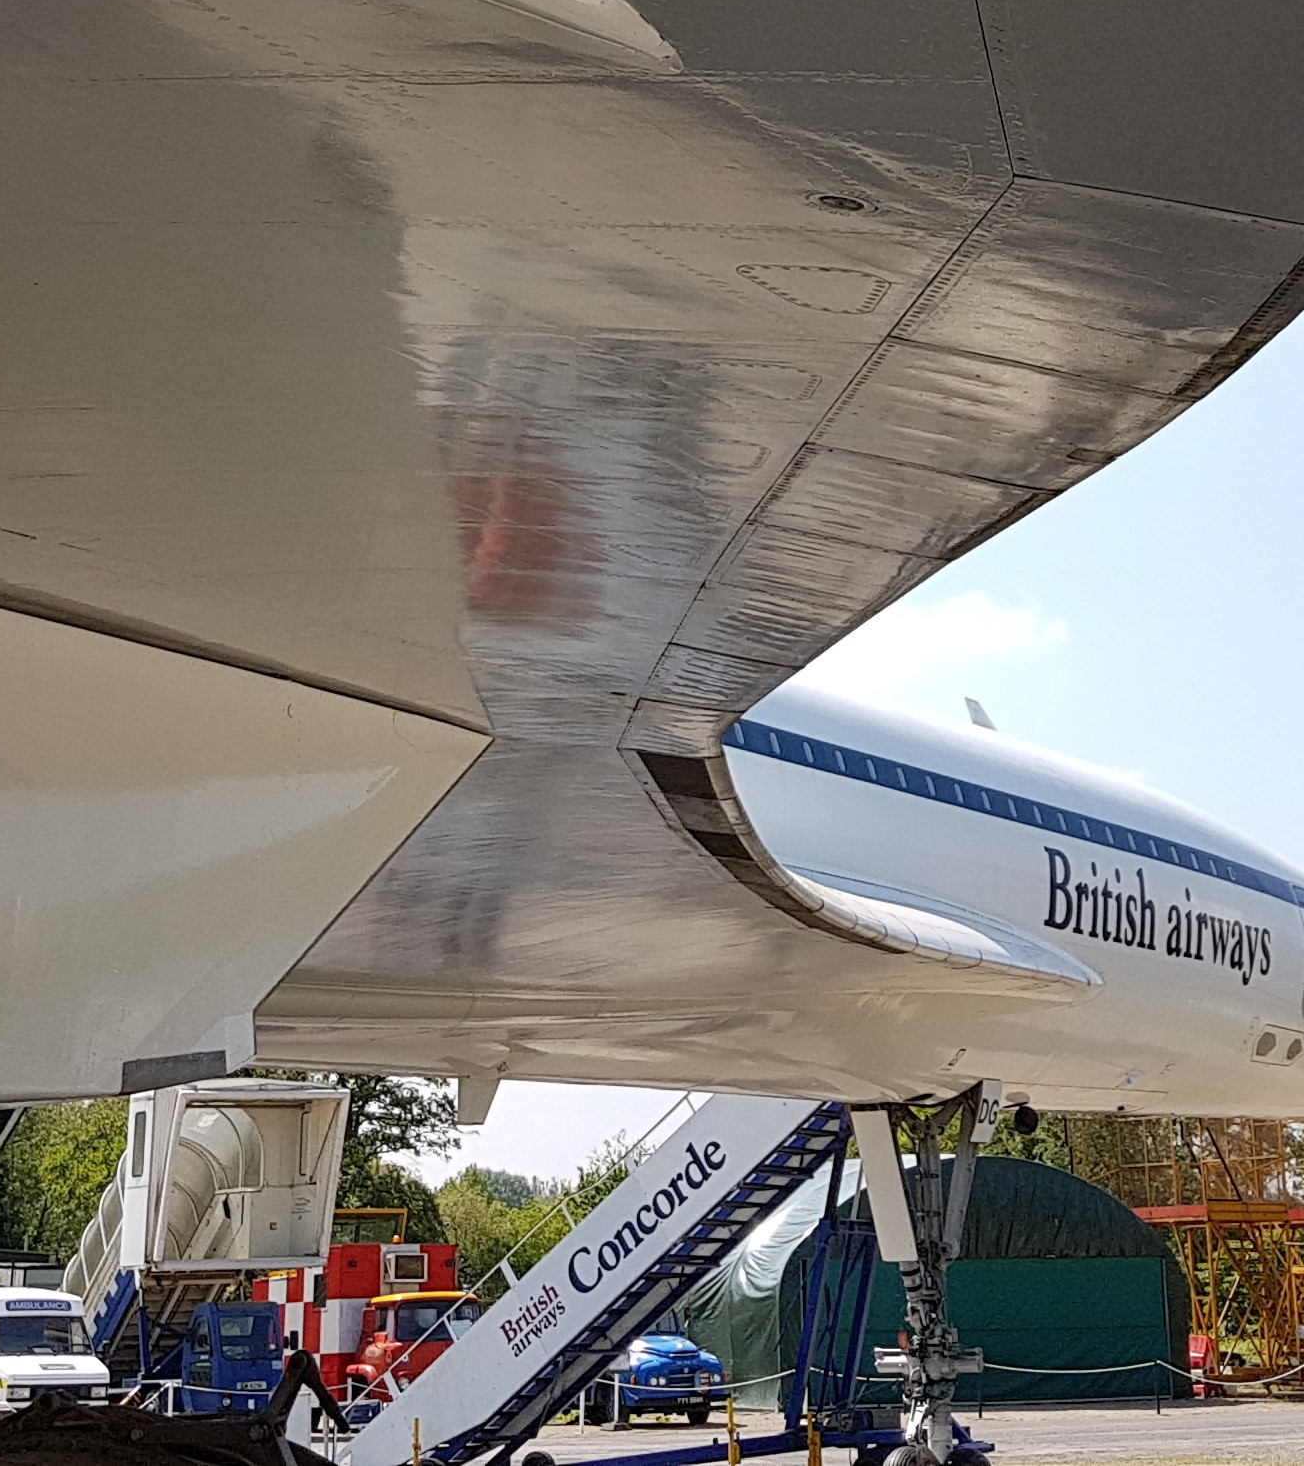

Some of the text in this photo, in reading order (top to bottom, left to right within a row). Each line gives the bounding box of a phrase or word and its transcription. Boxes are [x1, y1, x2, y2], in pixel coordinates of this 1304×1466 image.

[1043, 845, 1272, 986] British airways
[978, 1098, 1000, 1125] DG
[567, 1140, 727, 1294] Concorde
[499, 1283, 561, 1345] British
[511, 1299, 567, 1358] airways
